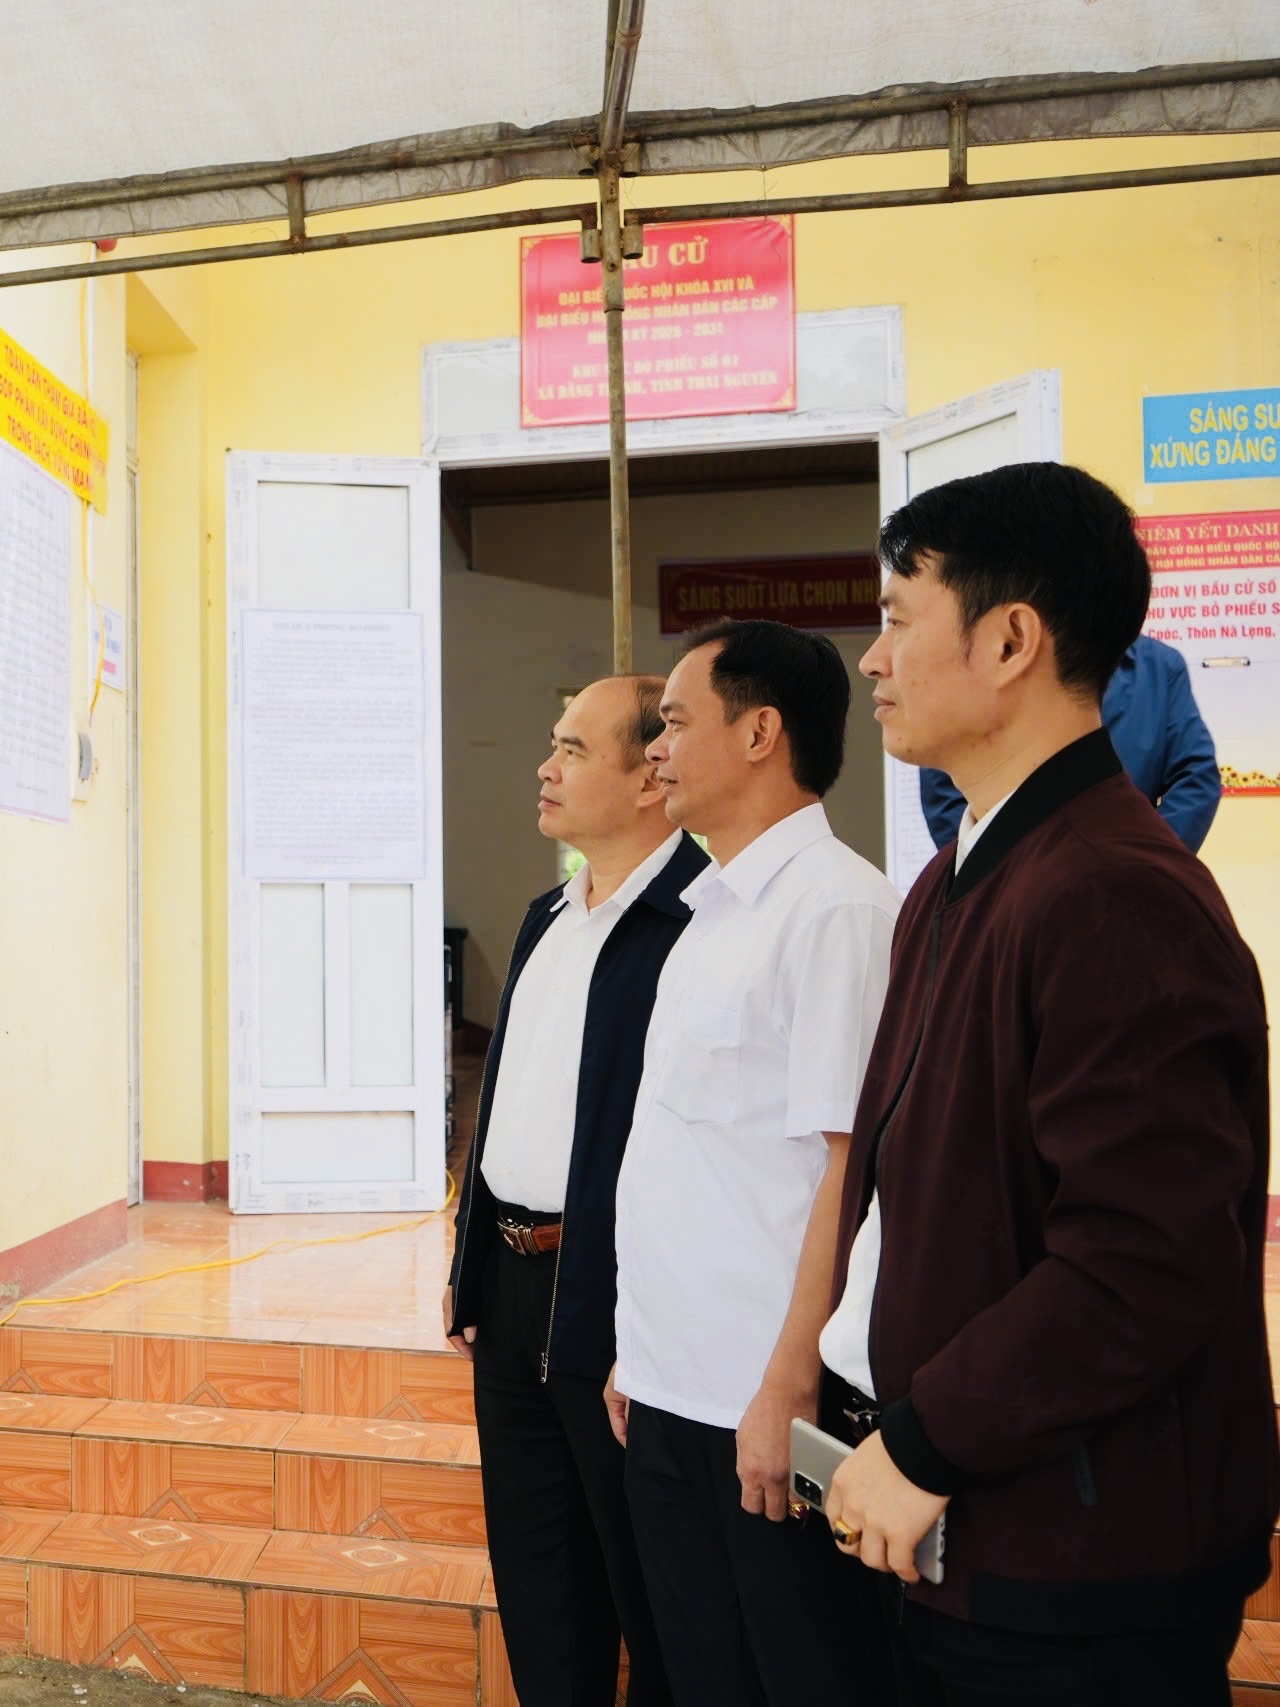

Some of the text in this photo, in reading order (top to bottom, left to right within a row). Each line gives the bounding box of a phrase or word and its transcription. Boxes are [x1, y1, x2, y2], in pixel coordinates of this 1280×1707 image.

[668, 234, 710, 267] CỬ
[1189, 400, 1249, 434] SÁNG
[1150, 432, 1277, 468] XỨNG ĐÁNG
[1185, 520, 1222, 539] YẾT
[1226, 521, 1280, 538] DANH
[1151, 577, 1277, 600] ĐƠN VỊ BẦU CỬ SỐ
[1170, 605, 1196, 621] VỰC
[1201, 601, 1220, 617] BỎ
[1225, 599, 1267, 616] PHIẾU
[1188, 626, 1217, 640] Thôn
[1221, 625, 1238, 638] Nà
[1242, 625, 1276, 641] Lẹng,
